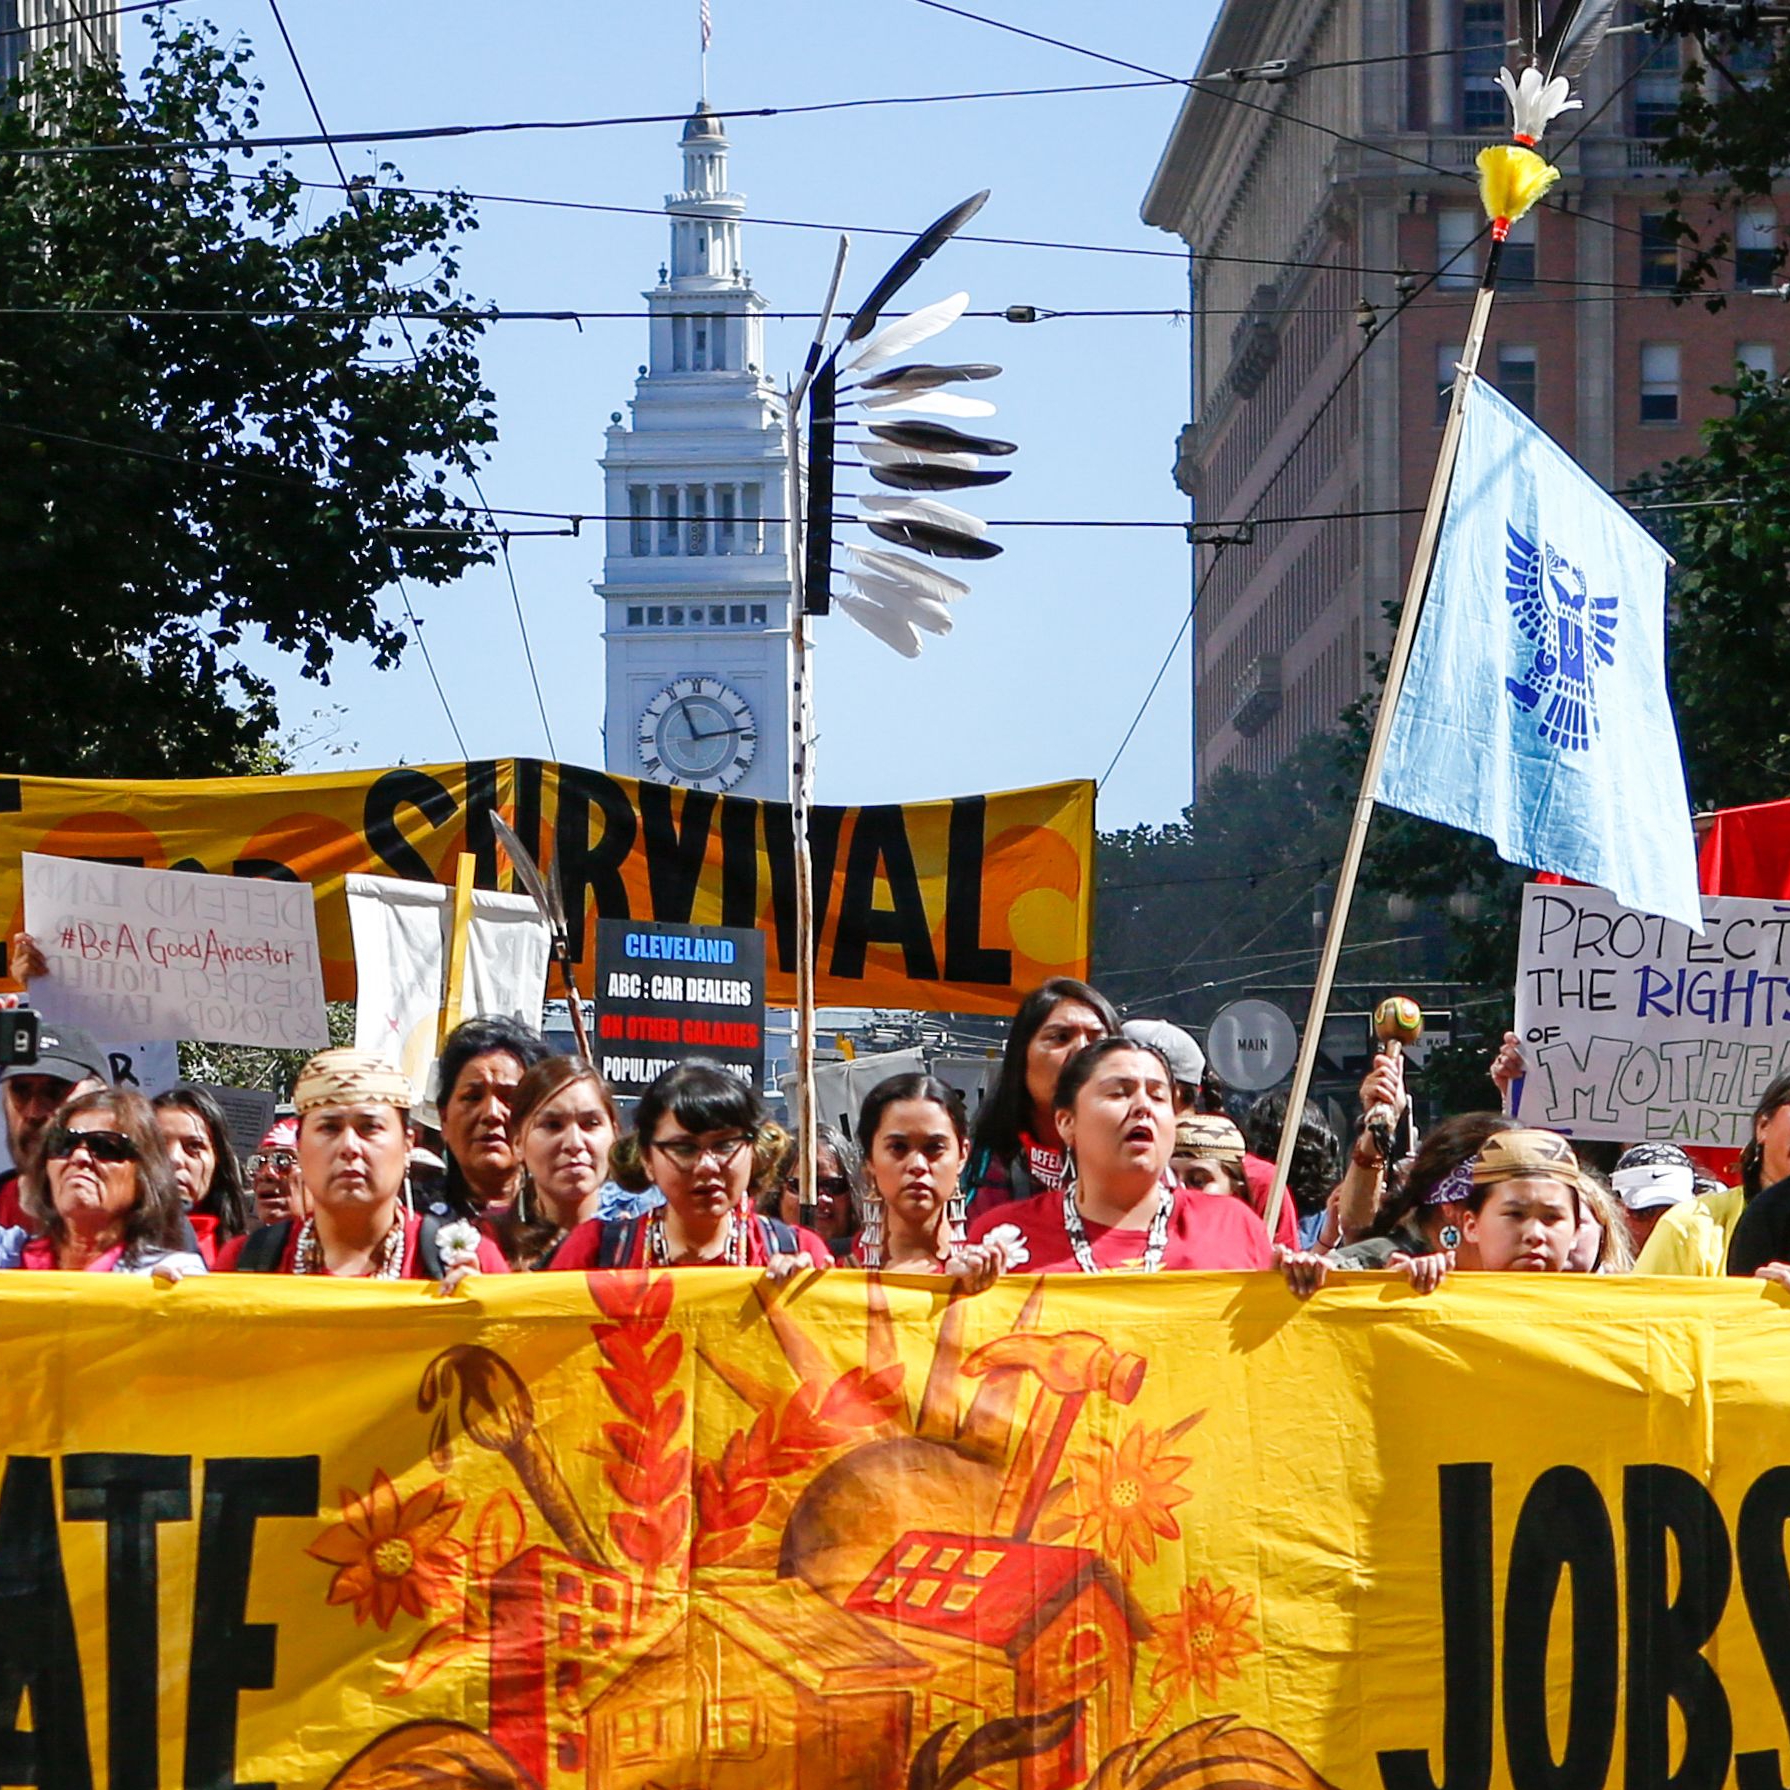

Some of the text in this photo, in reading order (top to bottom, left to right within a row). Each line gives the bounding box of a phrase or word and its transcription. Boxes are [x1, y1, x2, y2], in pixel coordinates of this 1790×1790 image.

[624, 933, 736, 965] CLEVELAND
[608, 972, 642, 999] ABC
[651, 974, 684, 1002] CAR
[686, 977, 754, 1007] DEALERS
[1526, 967, 1618, 1012] THE
[600, 1014, 760, 1050] ON OTHER GALAXIES
[1237, 1038, 1268, 1051] MAIN
[1526, 1026, 1562, 1044] OF
[1645, 1107, 1755, 1146] EART
